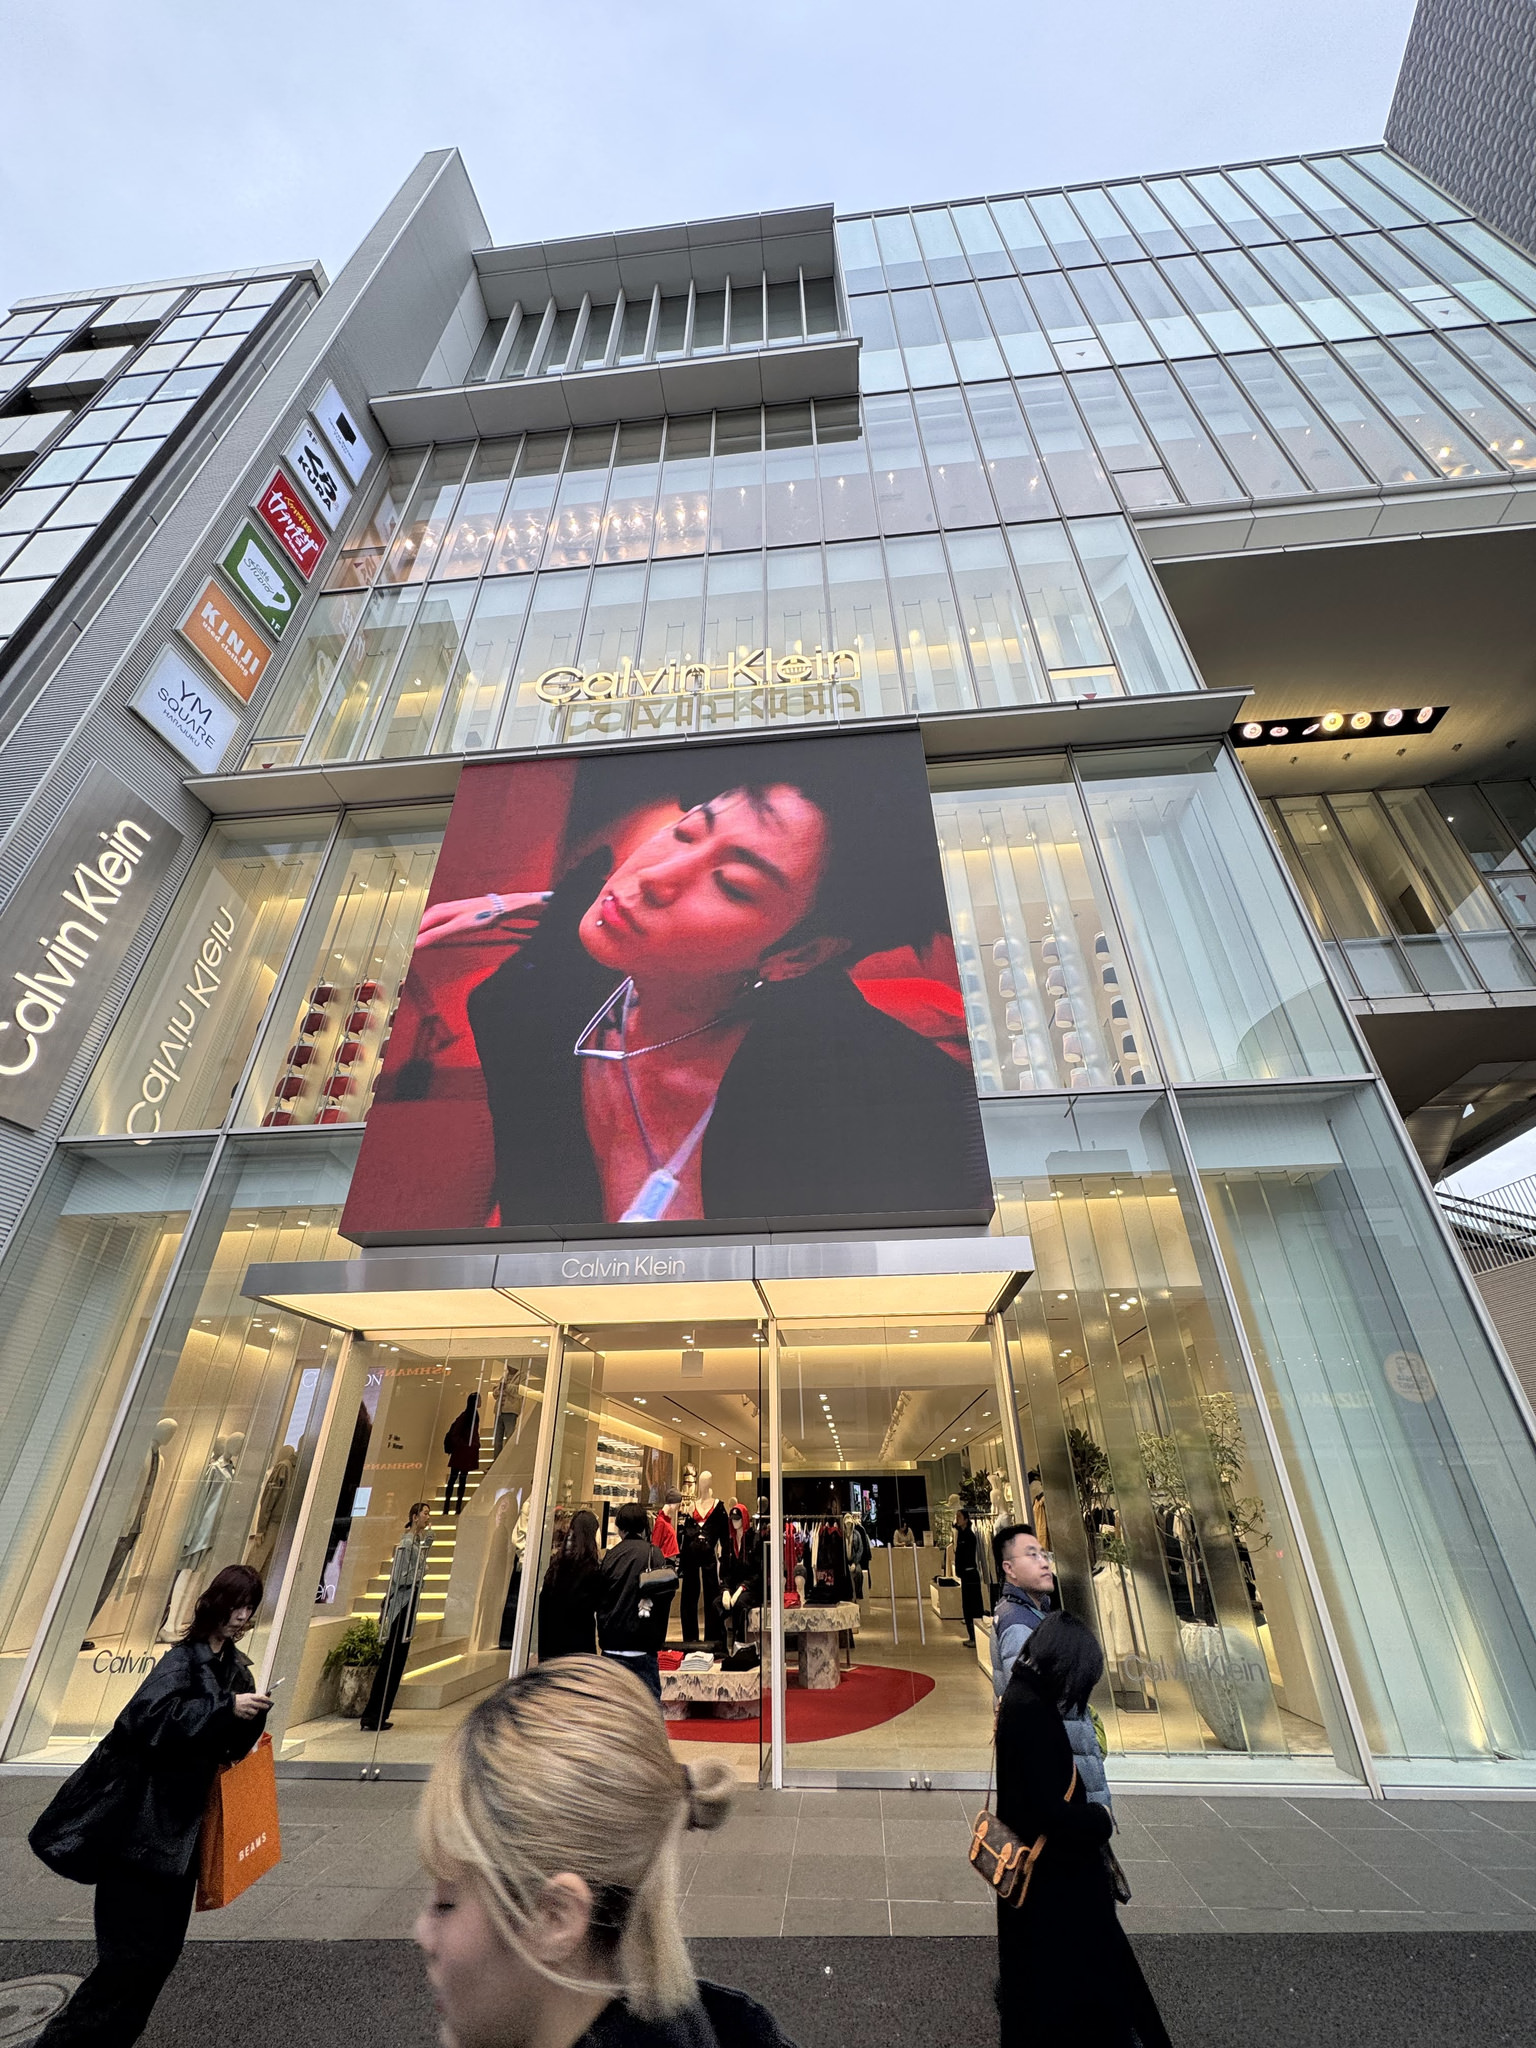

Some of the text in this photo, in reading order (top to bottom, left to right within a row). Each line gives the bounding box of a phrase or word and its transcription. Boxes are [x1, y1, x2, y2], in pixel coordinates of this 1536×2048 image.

[297, 455, 331, 512] KURA
[304, 445, 338, 502] くら
[201, 601, 260, 676] KINJI
[202, 621, 248, 677] used clothing
[271, 617, 281, 631] 1F
[535, 644, 860, 704] Calvin Klein
[157, 687, 216, 750] SQUARE
[163, 709, 200, 747] HARAJUKU
[181, 680, 213, 726] YM
[0, 819, 152, 1076] Calvin Klein
[561, 1255, 686, 1279] Calvin Klein
[93, 1649, 156, 1675] Calvin
[1124, 1654, 1266, 1682] Calvin Klein
[238, 1832, 267, 1861] BEAMS
